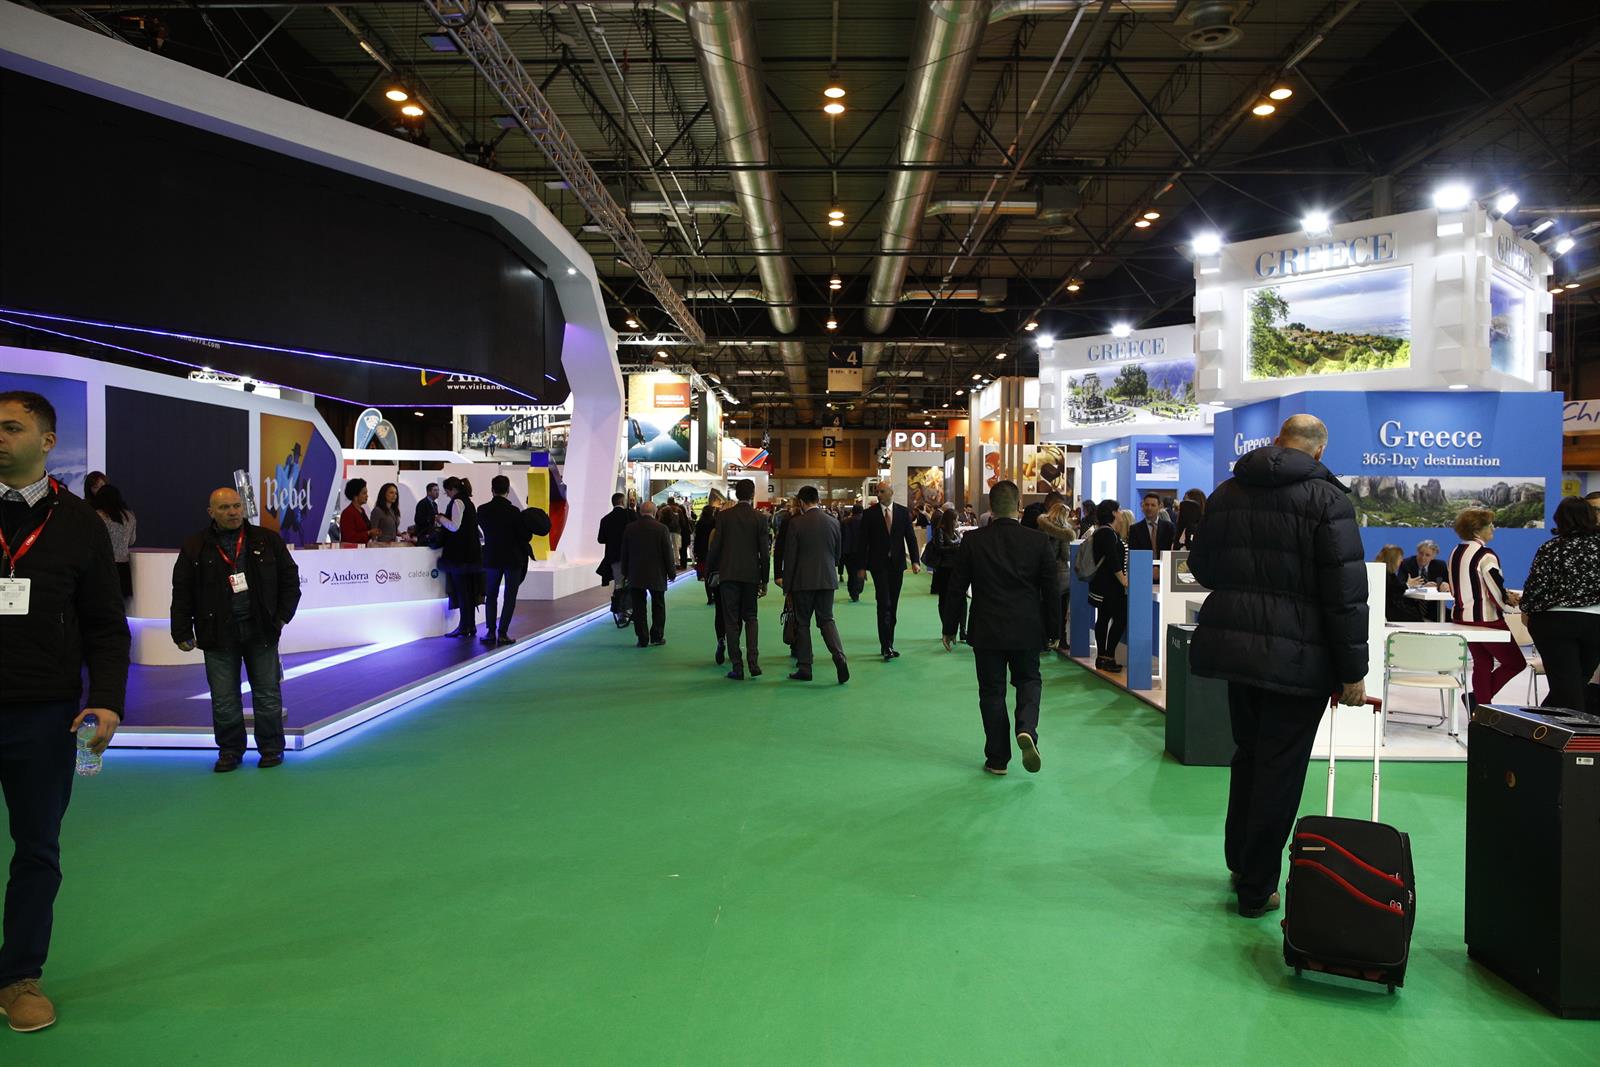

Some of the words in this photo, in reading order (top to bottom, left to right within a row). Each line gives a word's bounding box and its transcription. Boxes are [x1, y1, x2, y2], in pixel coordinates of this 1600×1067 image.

[1255, 232, 1395, 278] GREECE
[1087, 337, 1165, 362] GREECE
[847, 351, 858, 366] 4
[833, 416, 841, 426] 4
[1379, 420, 1482, 448] Greece
[824, 437, 834, 448] D
[654, 463, 700, 472] FINLAND
[1362, 452, 1418, 471] 365-Day
[1424, 452, 1501, 468] destination
[263, 475, 313, 512] Rebel
[331, 570, 369, 582] Andorra
[407, 569, 429, 579] caldea
